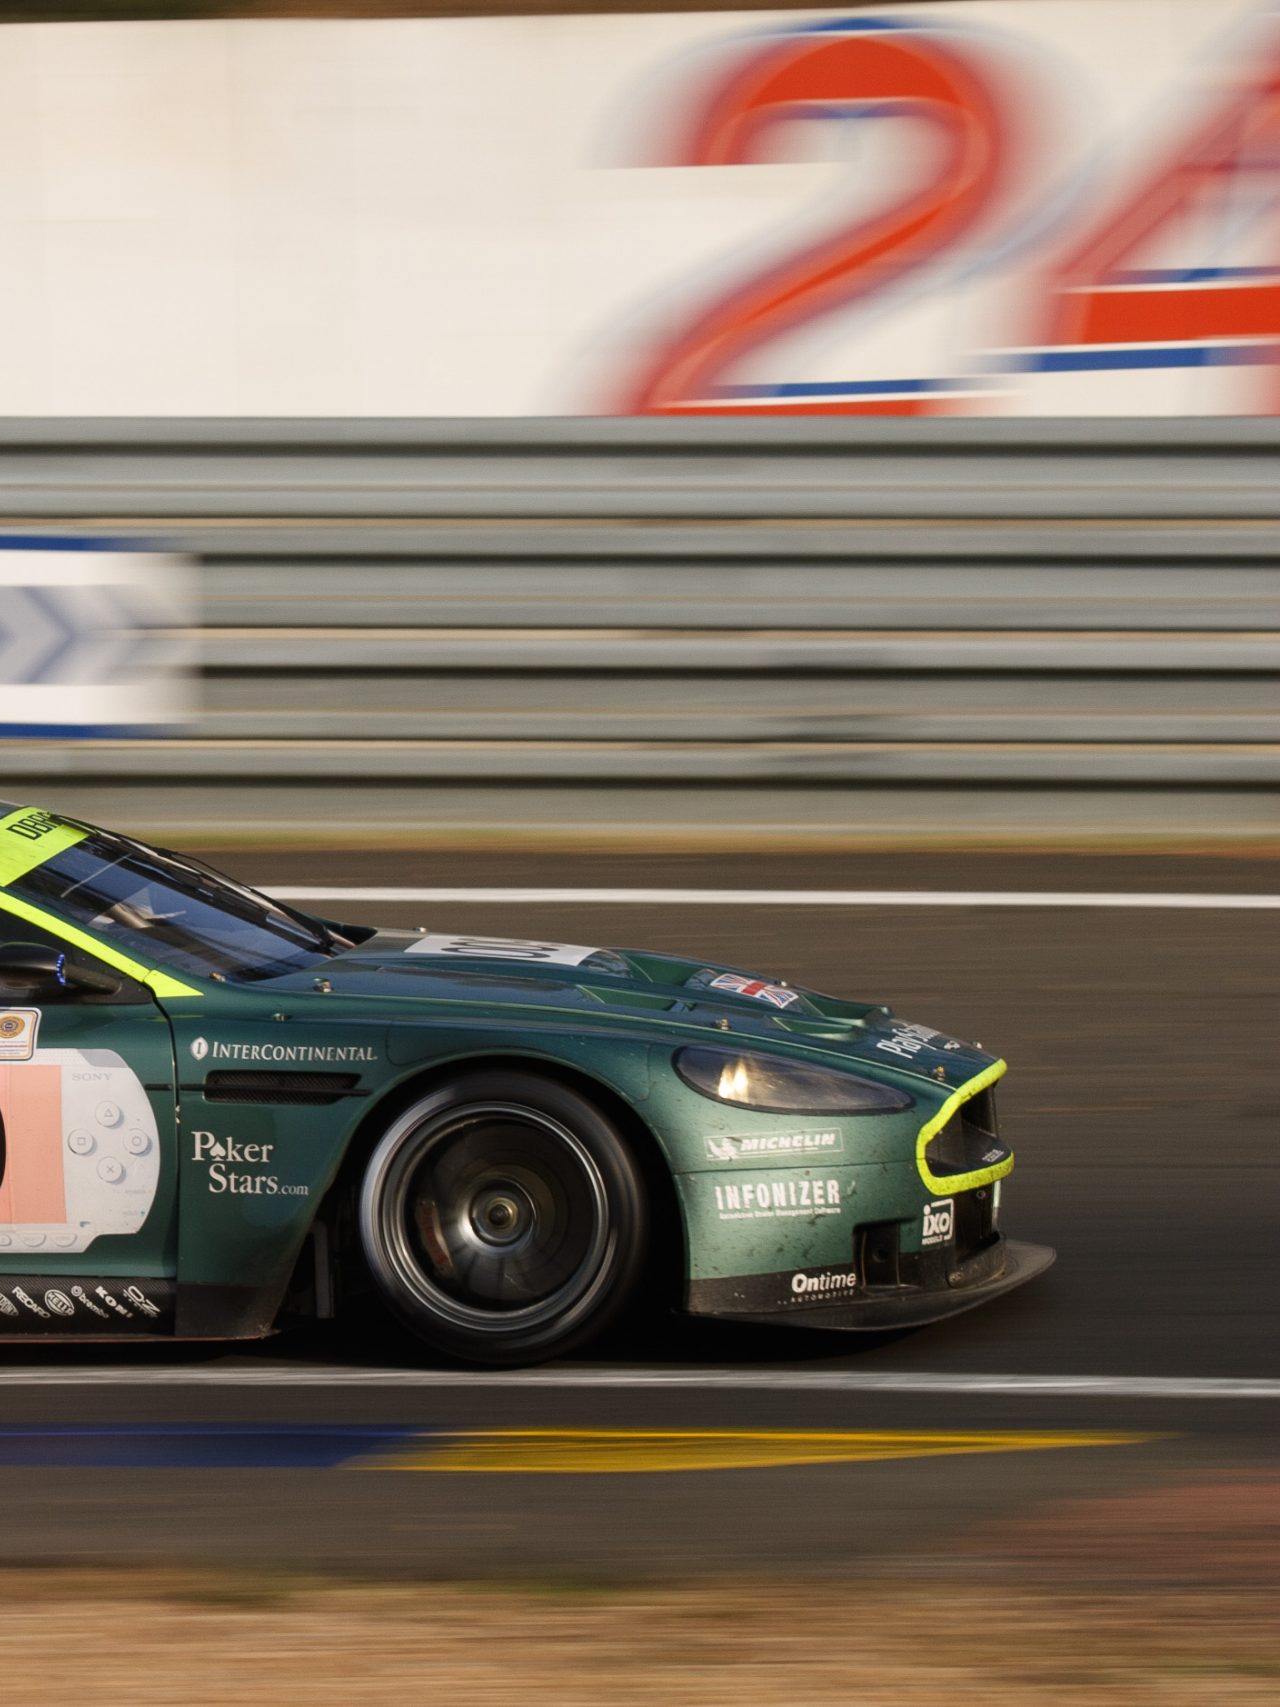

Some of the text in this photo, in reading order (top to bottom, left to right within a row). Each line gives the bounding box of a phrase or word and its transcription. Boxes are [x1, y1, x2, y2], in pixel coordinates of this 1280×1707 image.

[71, 1072, 113, 1081] SONY
[740, 1132, 836, 1151] MICHELIN
[714, 1178, 841, 1211] INFONIZER
[791, 1271, 857, 1294] Ontime
[11, 1285, 52, 1319] RECARO
[47, 1291, 75, 1316] HELLA
[79, 1292, 110, 1319] brembo
[95, 1285, 134, 1318] KONI
